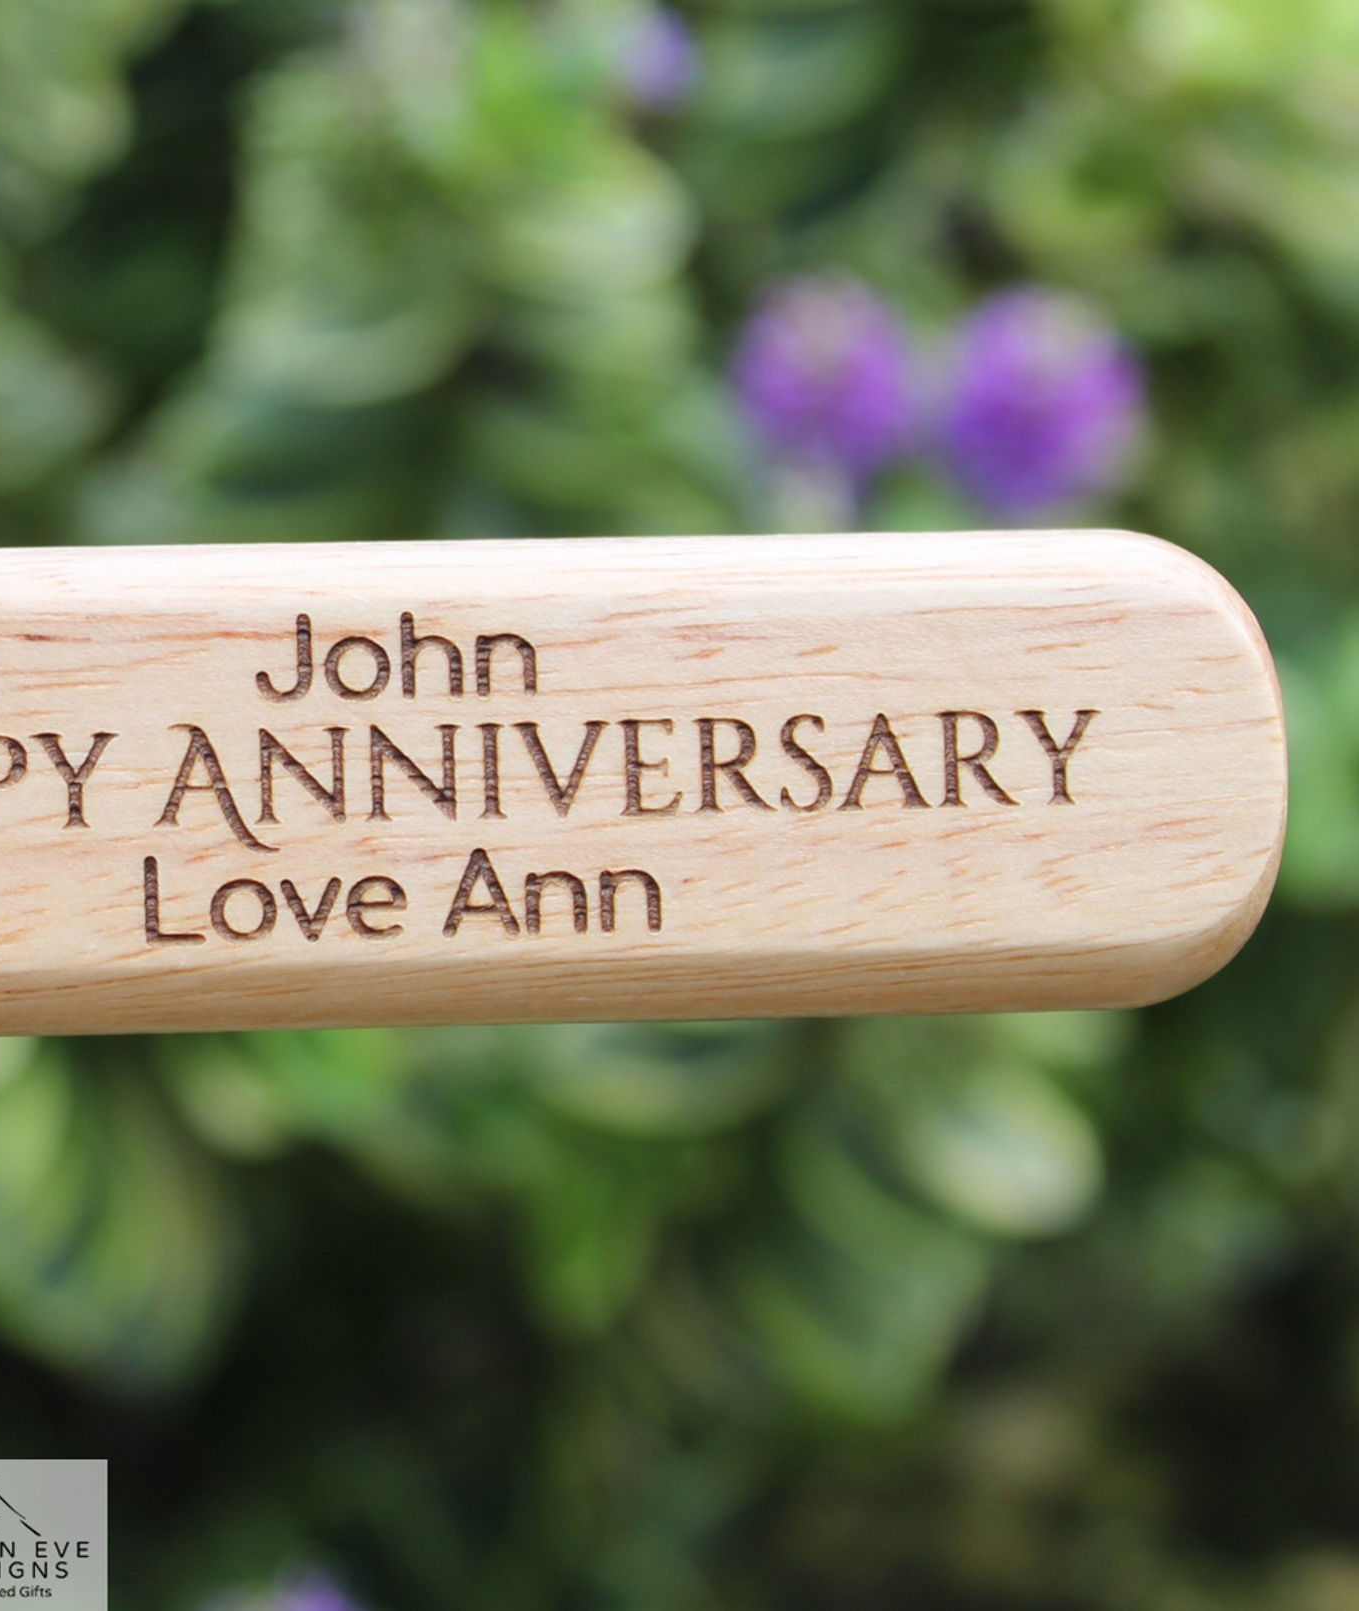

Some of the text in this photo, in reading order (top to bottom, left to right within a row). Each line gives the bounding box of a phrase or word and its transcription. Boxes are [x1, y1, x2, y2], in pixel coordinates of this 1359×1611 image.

[254, 612, 539, 703] John
[142, 847, 663, 944] Love Ann
